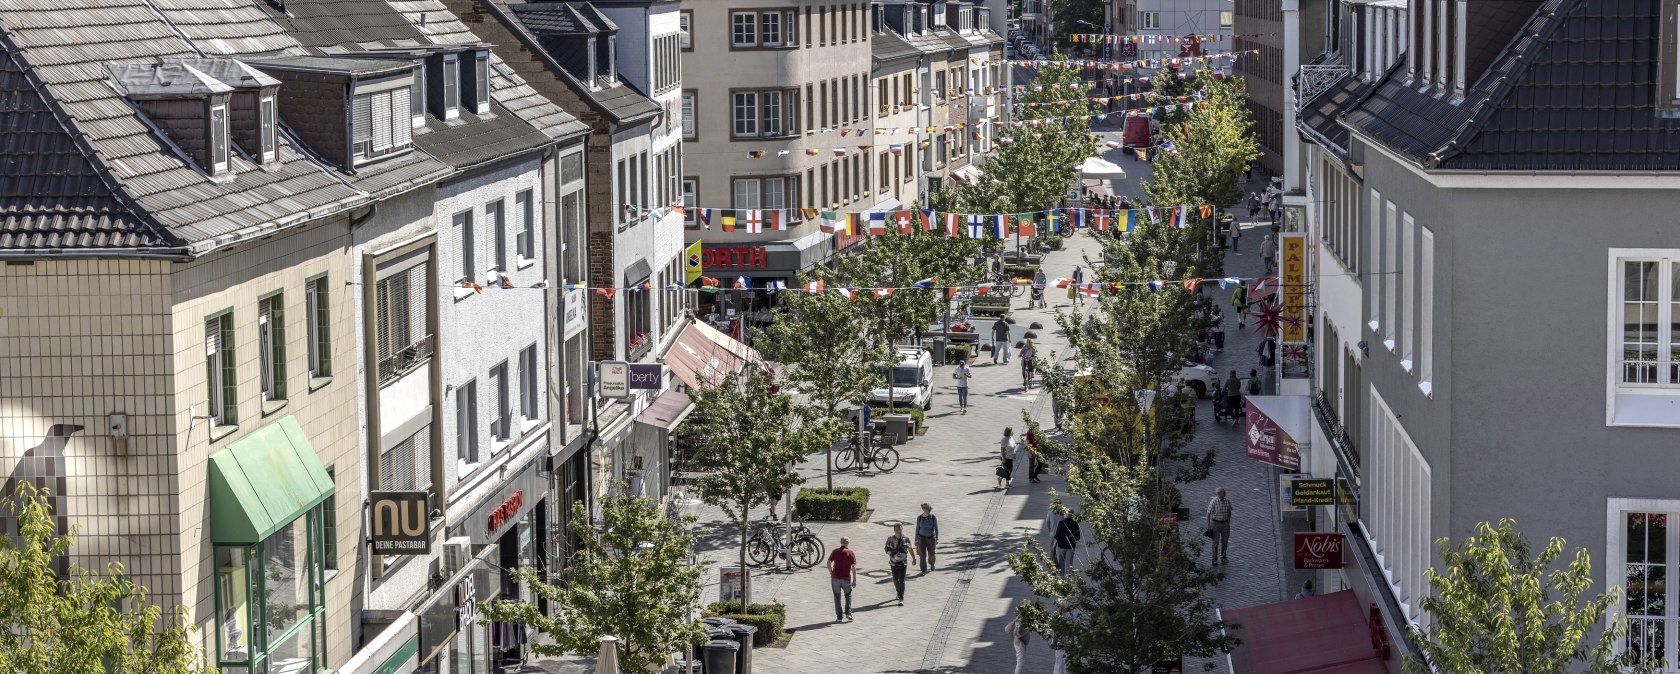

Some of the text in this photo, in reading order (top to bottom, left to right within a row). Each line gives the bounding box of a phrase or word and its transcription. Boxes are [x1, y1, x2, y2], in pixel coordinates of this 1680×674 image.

[701, 247, 767, 269] ORTH
[375, 541, 426, 549] DEINE PASTABAR
[1296, 535, 1340, 558] Nobis
